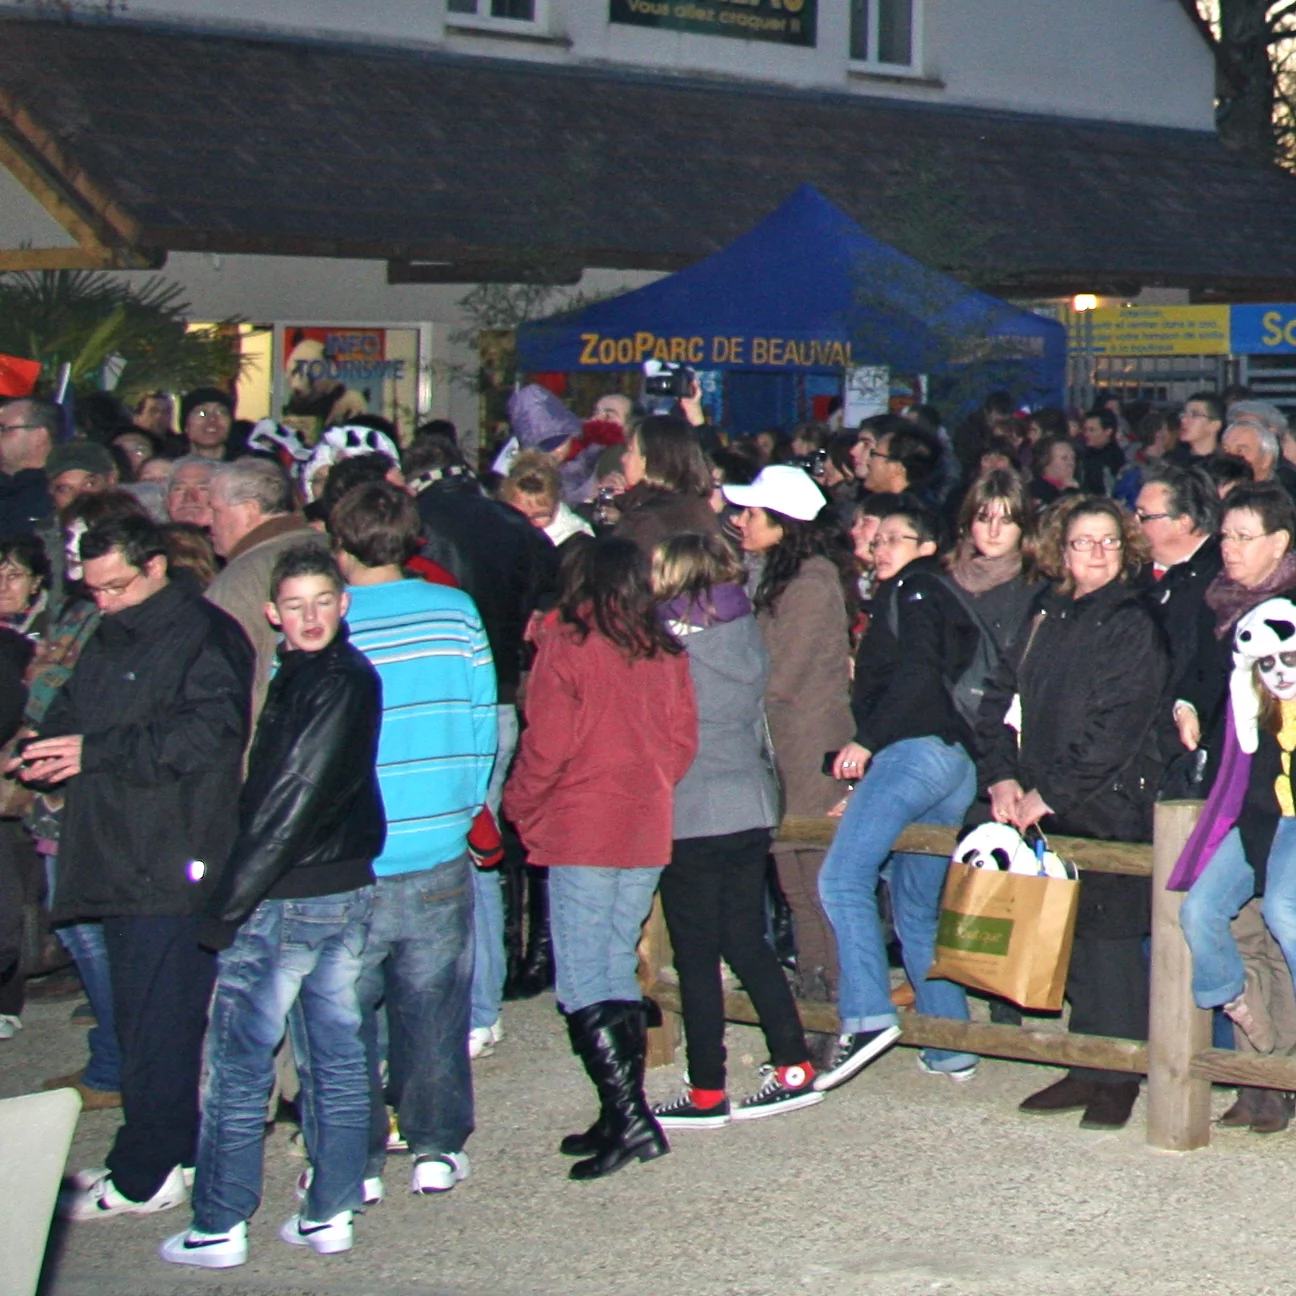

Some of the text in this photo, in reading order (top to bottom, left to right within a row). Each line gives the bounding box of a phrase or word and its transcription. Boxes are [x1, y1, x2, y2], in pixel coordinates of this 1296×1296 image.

[325, 333, 380, 356] INFO
[712, 335, 744, 363] DE
[752, 337, 853, 366] BEAUVAL
[296, 359, 404, 380] TOURISME
